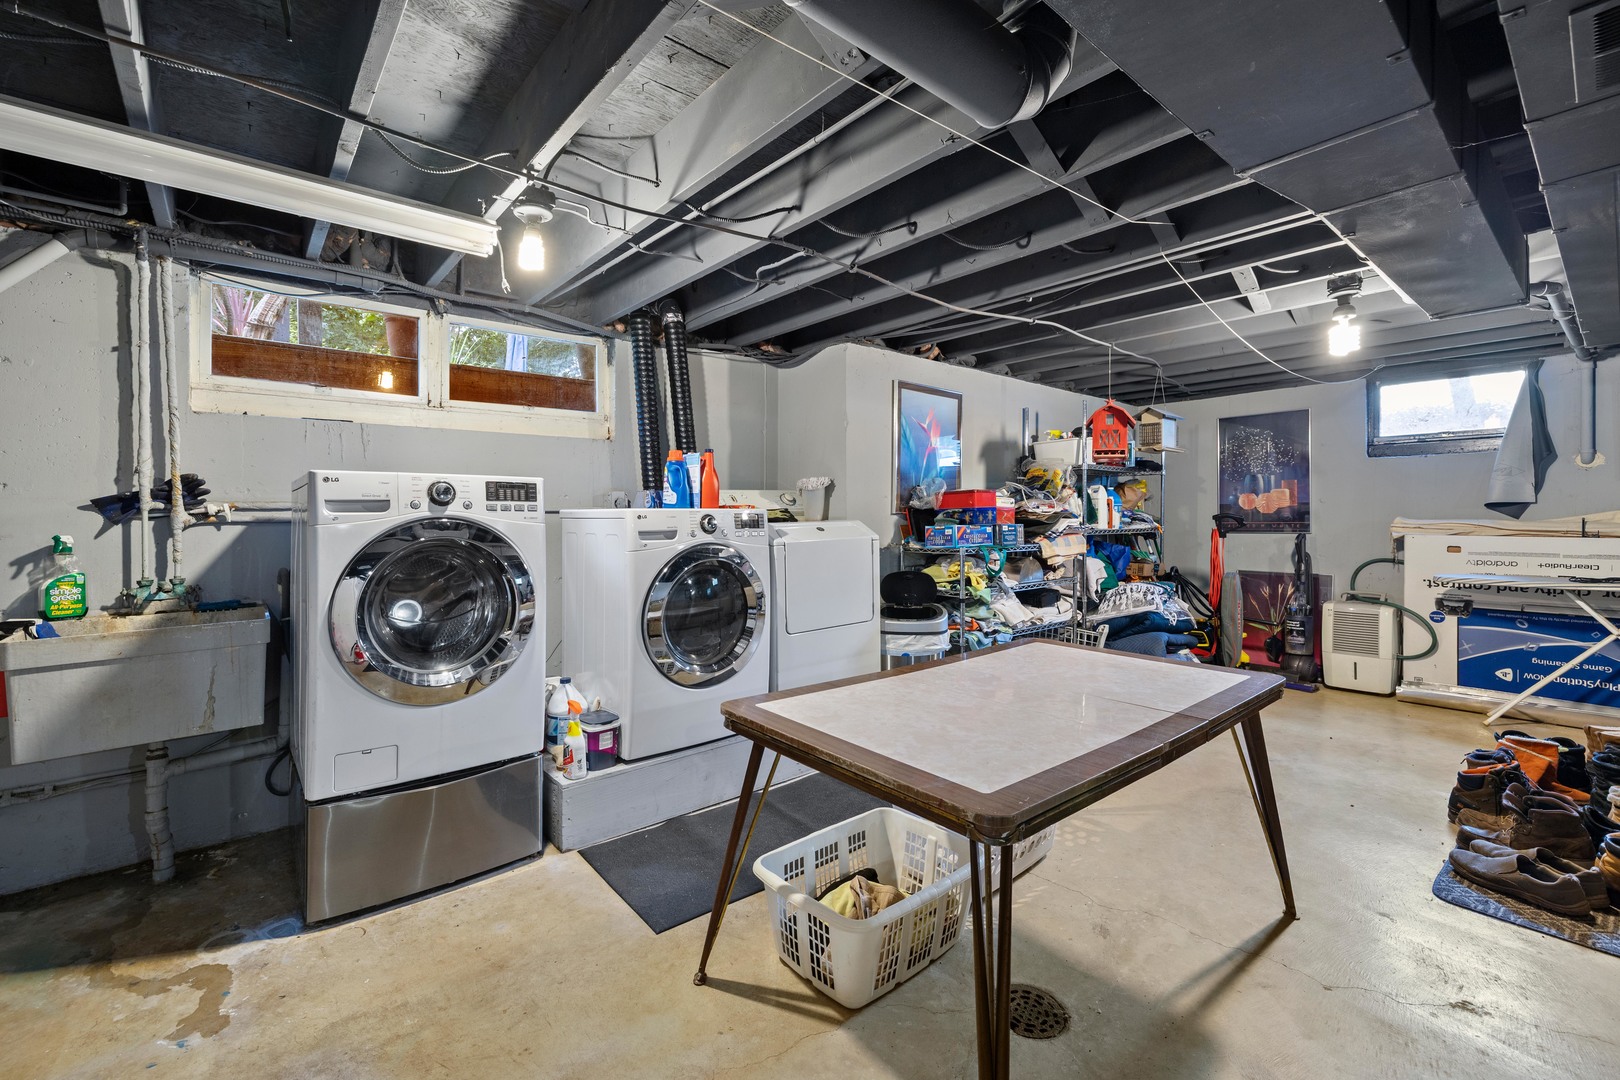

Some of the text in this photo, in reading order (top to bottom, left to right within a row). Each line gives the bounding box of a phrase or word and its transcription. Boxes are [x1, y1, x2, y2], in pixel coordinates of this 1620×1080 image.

[1537, 562, 1600, 571] ClearAudio+
[49, 587, 82, 595] simple
[1534, 587, 1591, 598] clrity
[50, 594, 81, 603] green
[1532, 657, 1613, 673] Game Seaming
